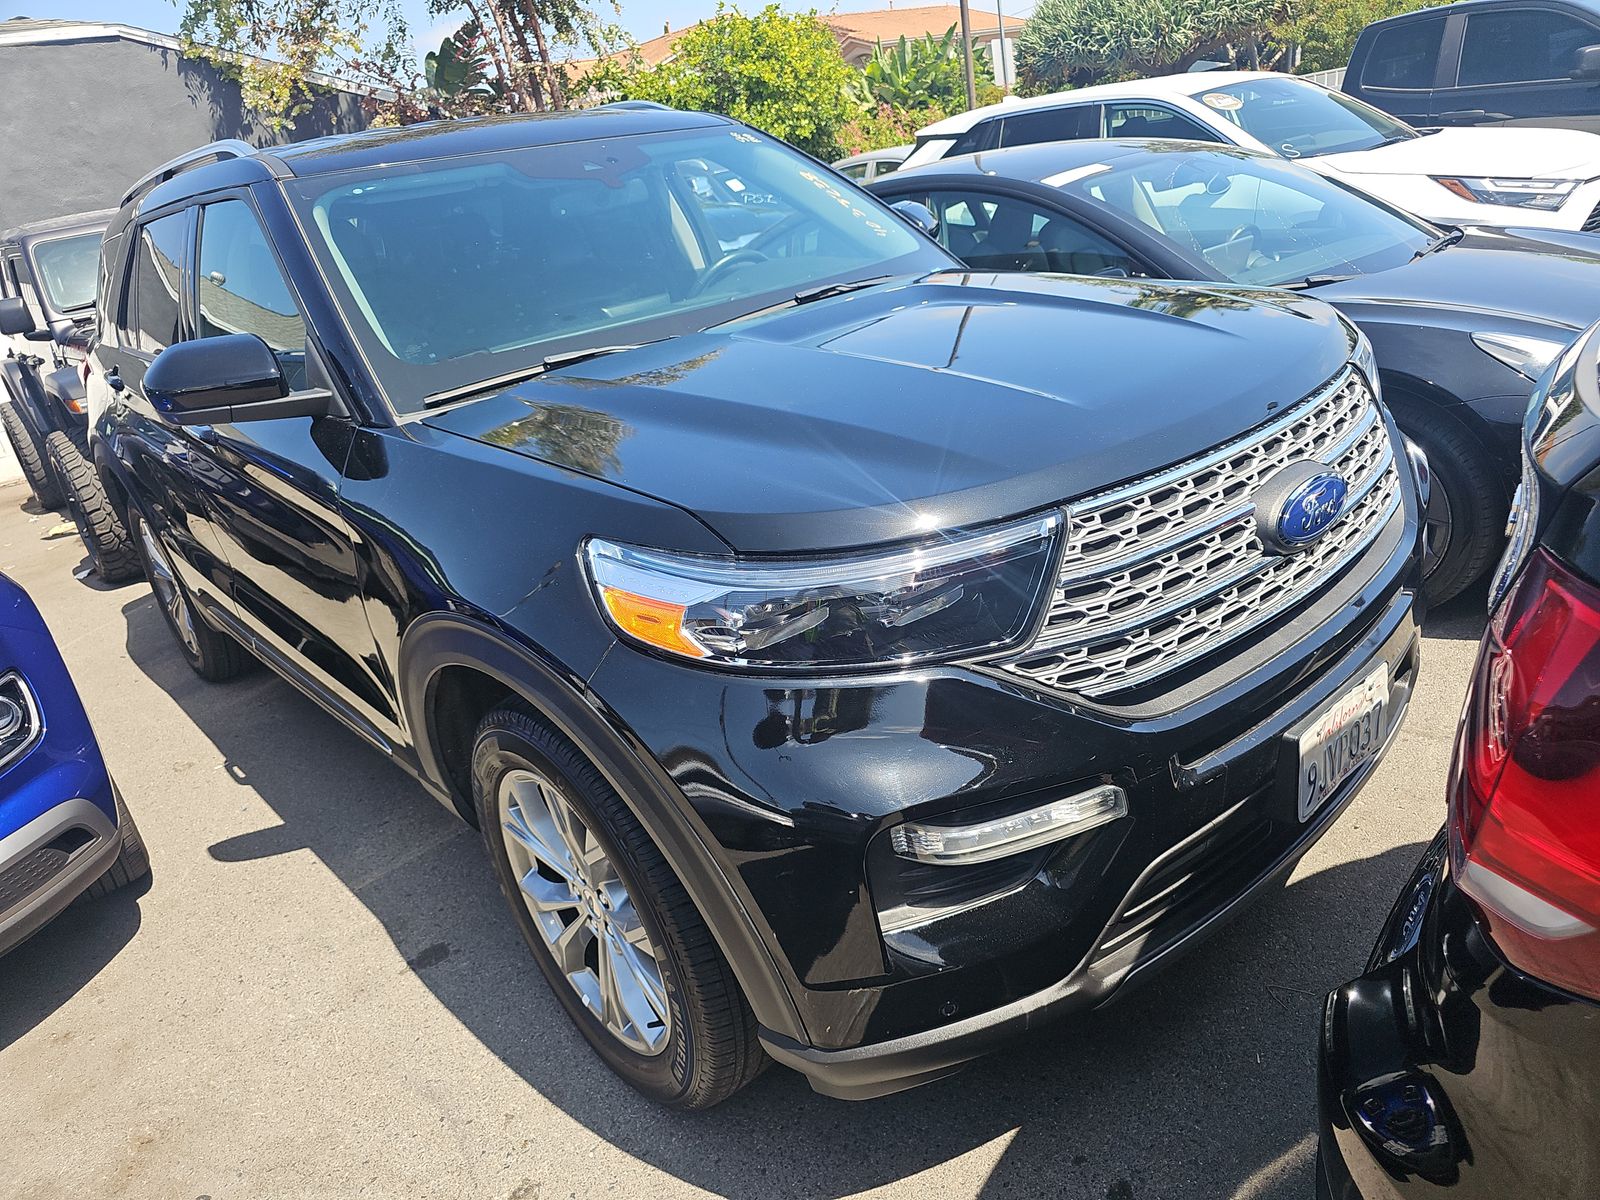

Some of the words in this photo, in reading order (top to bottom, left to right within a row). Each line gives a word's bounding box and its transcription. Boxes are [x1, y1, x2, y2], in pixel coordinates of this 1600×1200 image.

[1281, 143, 1301, 158] S
[1302, 487, 1338, 532] Ford
[1317, 690, 1369, 745] Californi
[1306, 699, 1382, 808] 9JYP037
[670, 997, 687, 1083] MICHELIN
